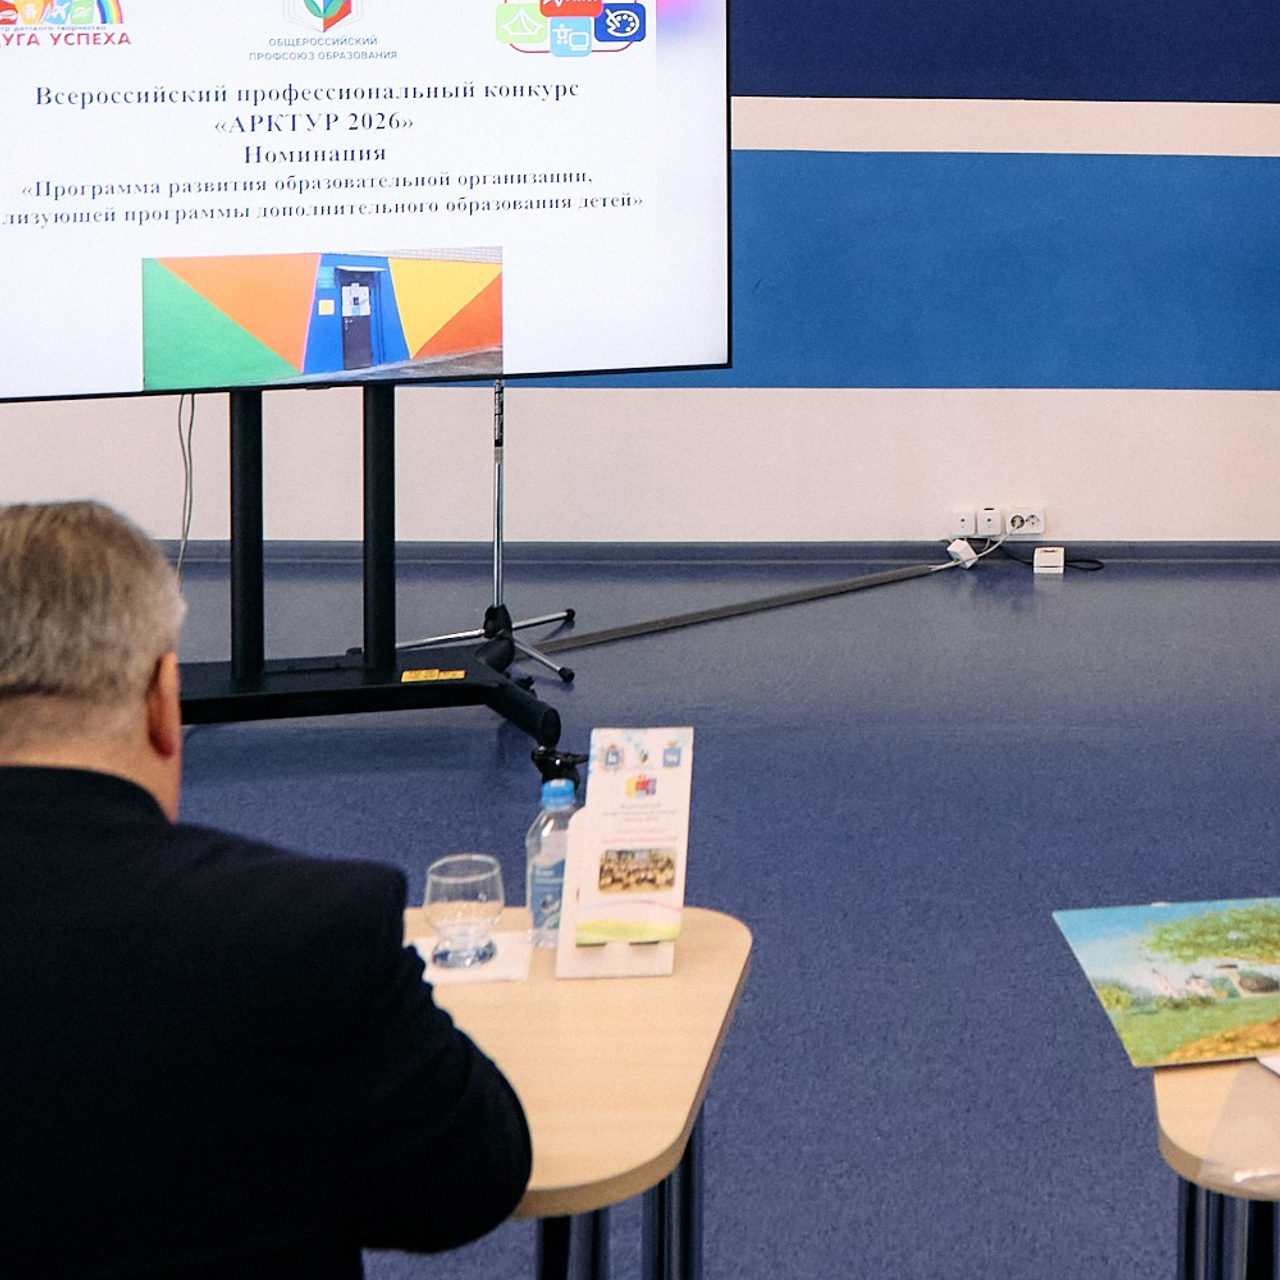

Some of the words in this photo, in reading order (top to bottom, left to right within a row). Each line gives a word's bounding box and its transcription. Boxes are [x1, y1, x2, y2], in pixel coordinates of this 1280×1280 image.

[0, 33, 40, 48] УГА
[50, 32, 131, 46] УСПЕХА
[268, 34, 378, 47] ОБЩЕРОССИЙСКИЙ
[249, 51, 315, 61] ПРОФСОЮЗ
[318, 51, 398, 60] ОБРАЗОВАНИЯ
[36, 85, 228, 109] Всероссийский
[237, 82, 476, 106] профессиональный
[484, 82, 579, 101] конкурс
[214, 112, 339, 133] «АРКТУР
[348, 111, 414, 131] 2026»
[244, 145, 386, 164] Номинация
[22, 181, 160, 200] «Программа
[169, 178, 267, 198] развития
[275, 172, 450, 194] образовательной
[458, 171, 593, 192] организации,
[125, 204, 250, 226] программы
[256, 200, 439, 220] дополнительного
[446, 196, 572, 217] образования
[578, 191, 643, 211] детей»
